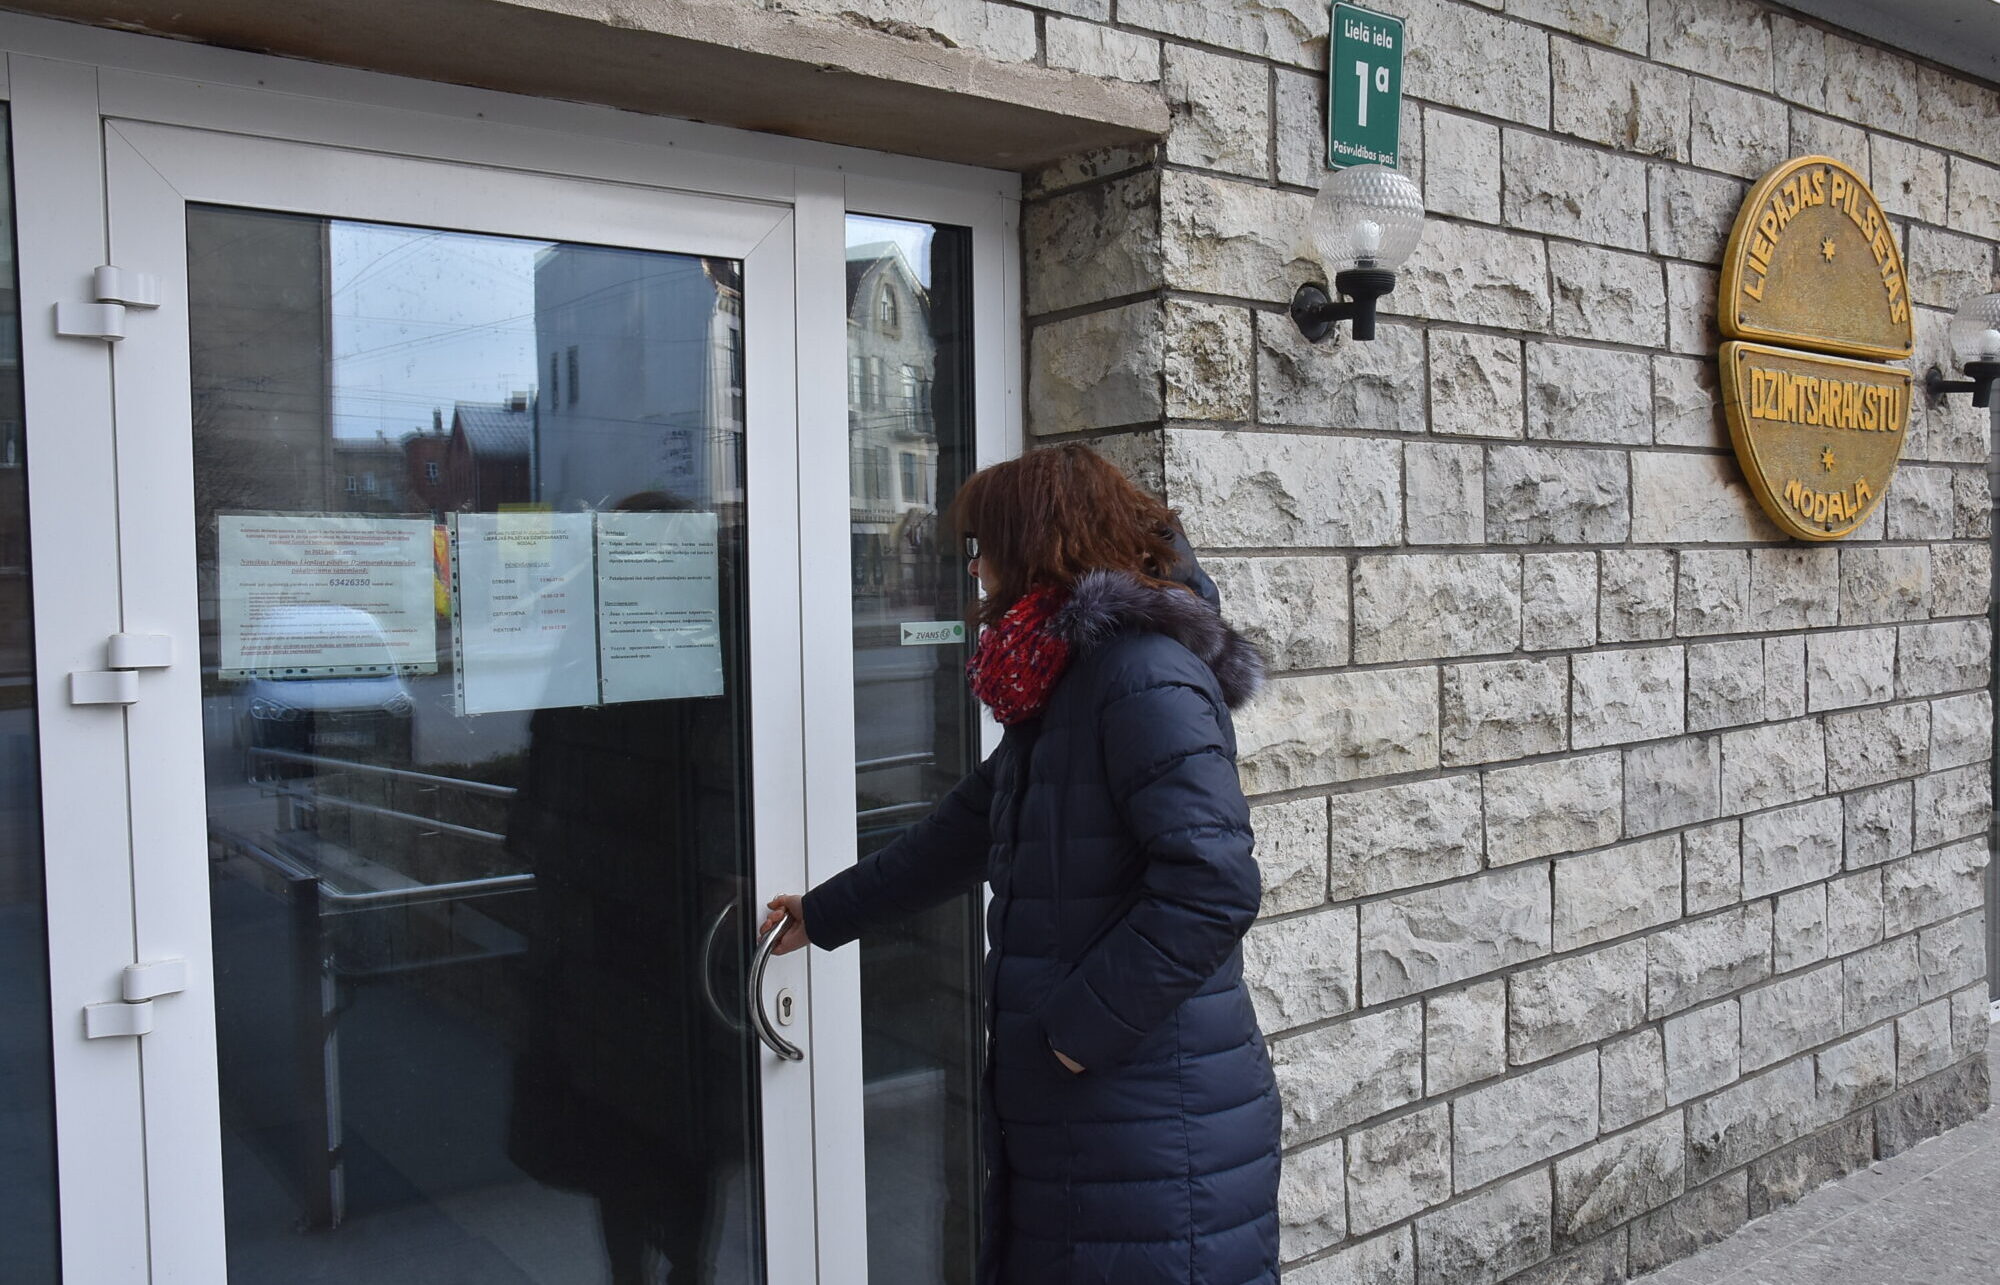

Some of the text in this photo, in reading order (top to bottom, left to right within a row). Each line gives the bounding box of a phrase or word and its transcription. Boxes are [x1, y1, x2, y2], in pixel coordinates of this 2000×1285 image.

[1344, 19, 1393, 49] Lielā iela
[1750, 367, 1900, 432] DZIMTSARAKSTU
[916, 631, 939, 640] ZVANS
